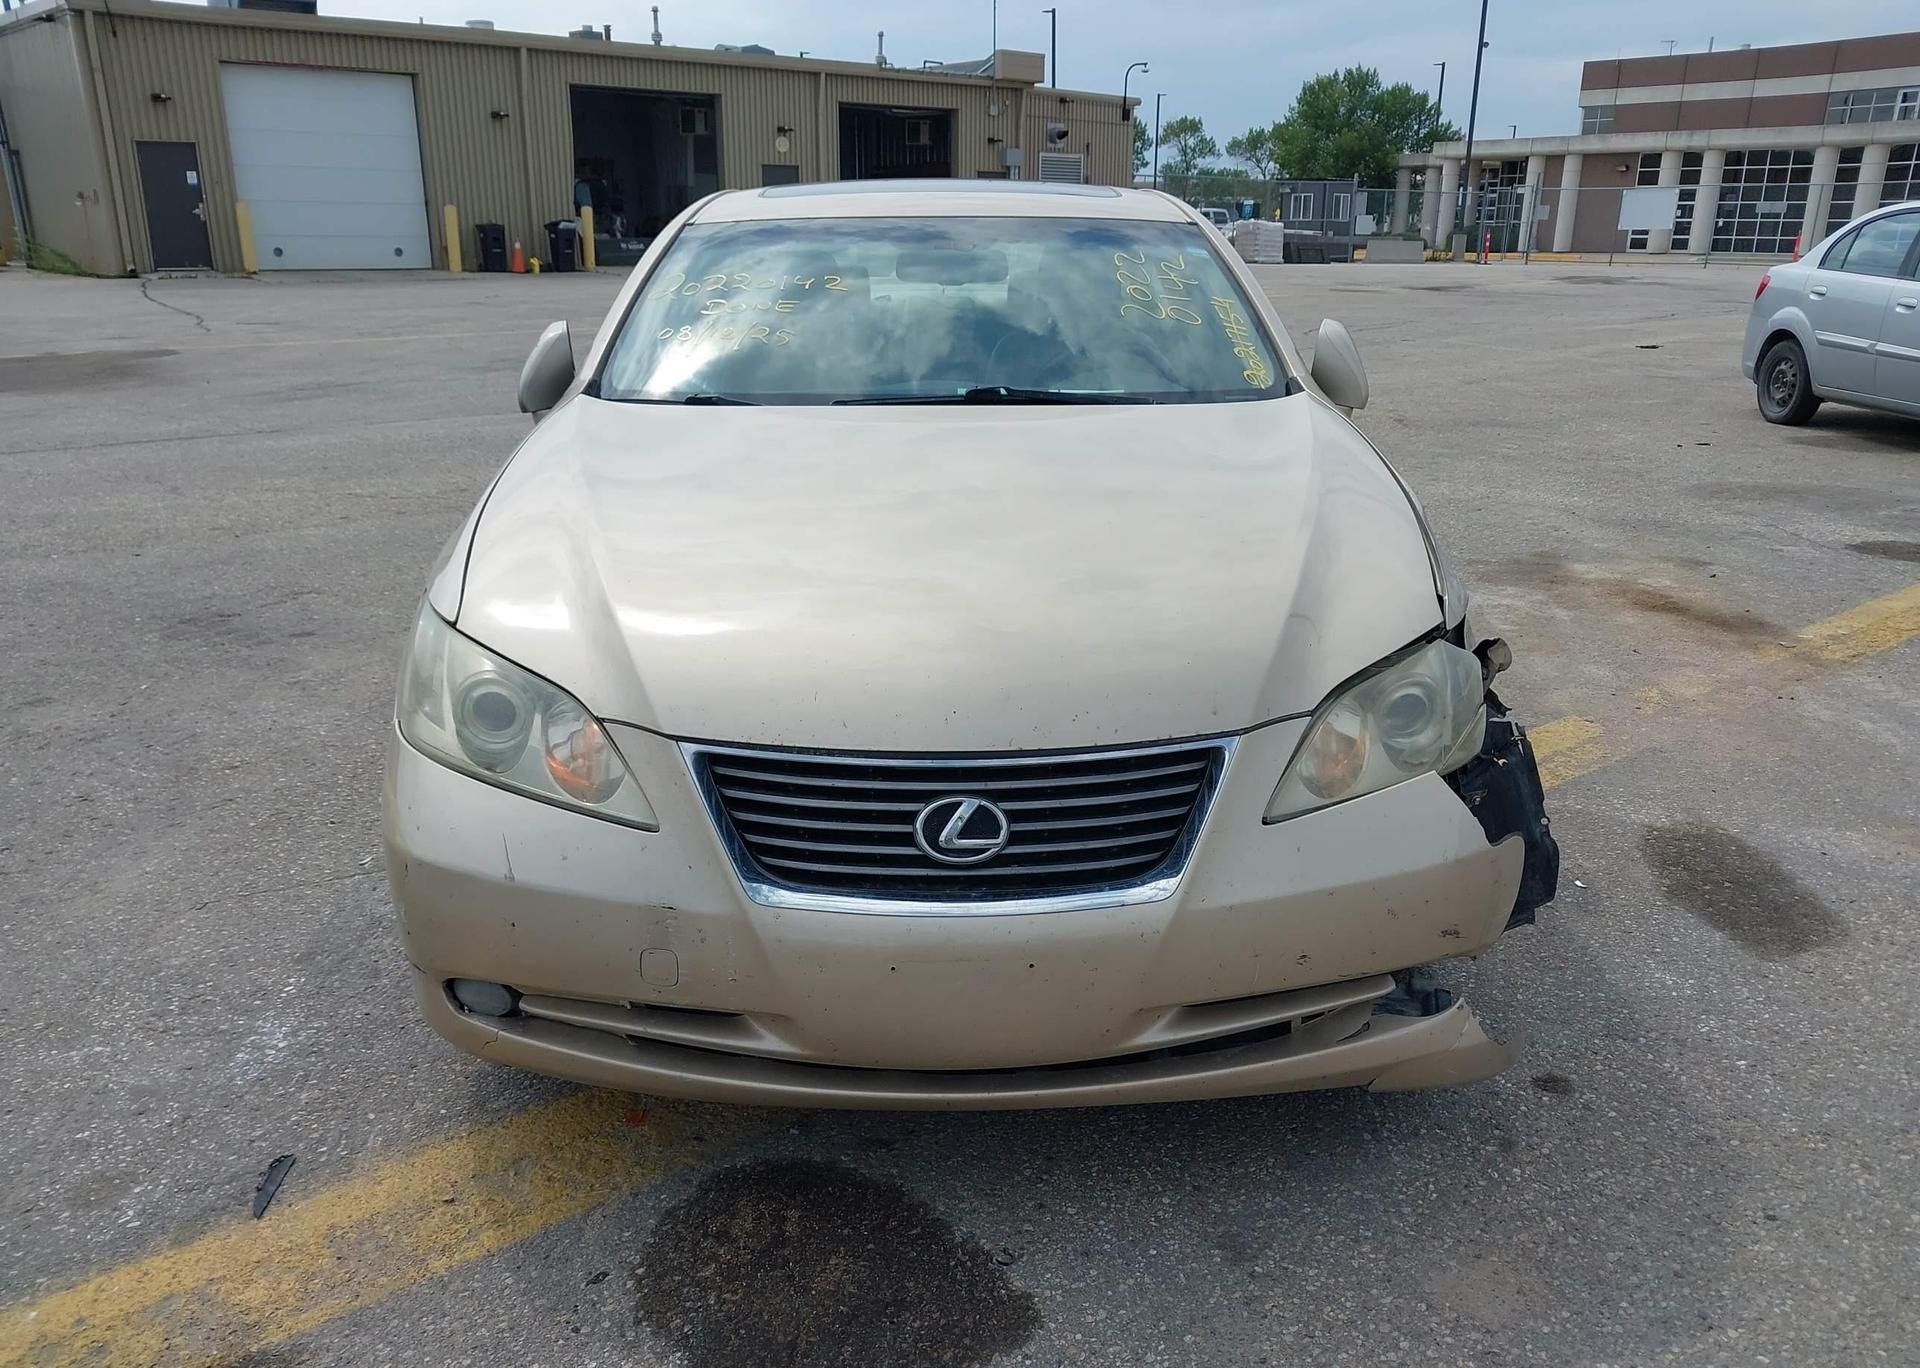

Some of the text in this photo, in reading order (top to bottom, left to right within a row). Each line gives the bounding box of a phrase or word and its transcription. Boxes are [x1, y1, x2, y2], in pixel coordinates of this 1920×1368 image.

[649, 272, 848, 299] 20220142
[700, 300, 800, 315] DONE
[1115, 250, 1166, 320] 2022
[1158, 253, 1202, 325] 0142
